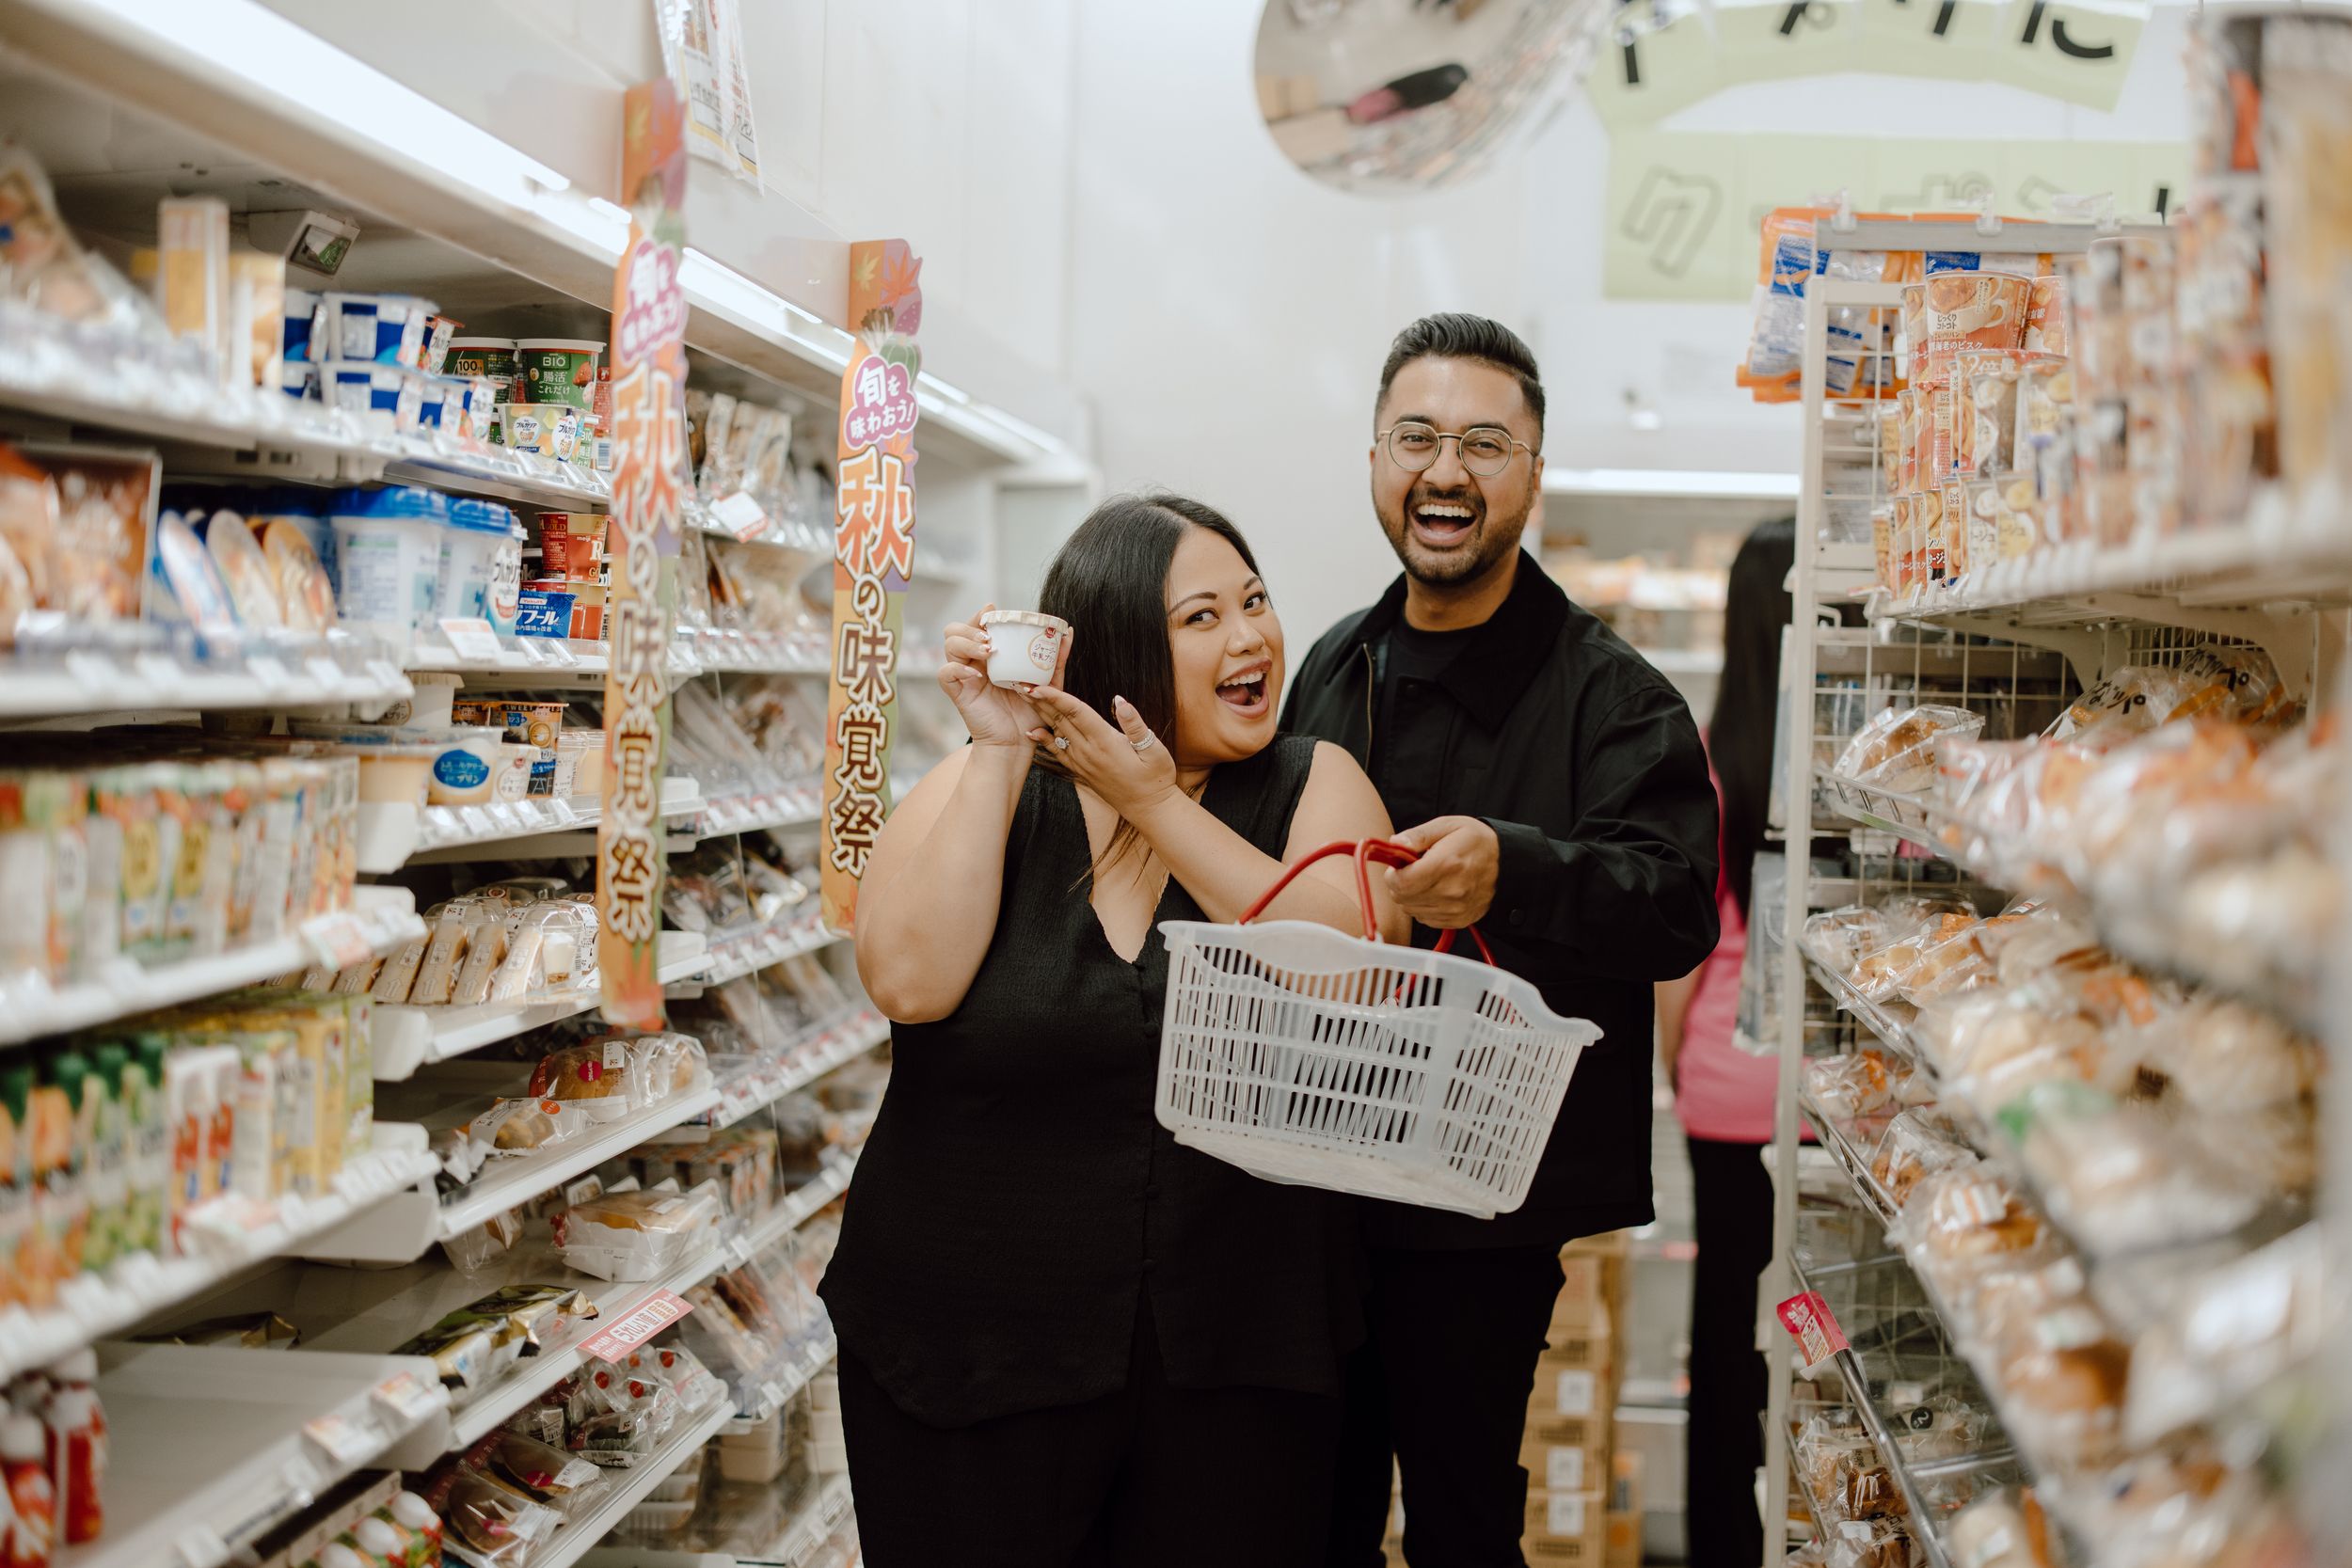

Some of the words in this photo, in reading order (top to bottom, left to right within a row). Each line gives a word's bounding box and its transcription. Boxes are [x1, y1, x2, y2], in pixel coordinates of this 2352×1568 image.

[543, 356, 565, 367] BIO
[857, 365, 900, 408] 旬を
[850, 402, 914, 440] 味わおう!
[828, 444, 915, 879] 秋の味覚祭
